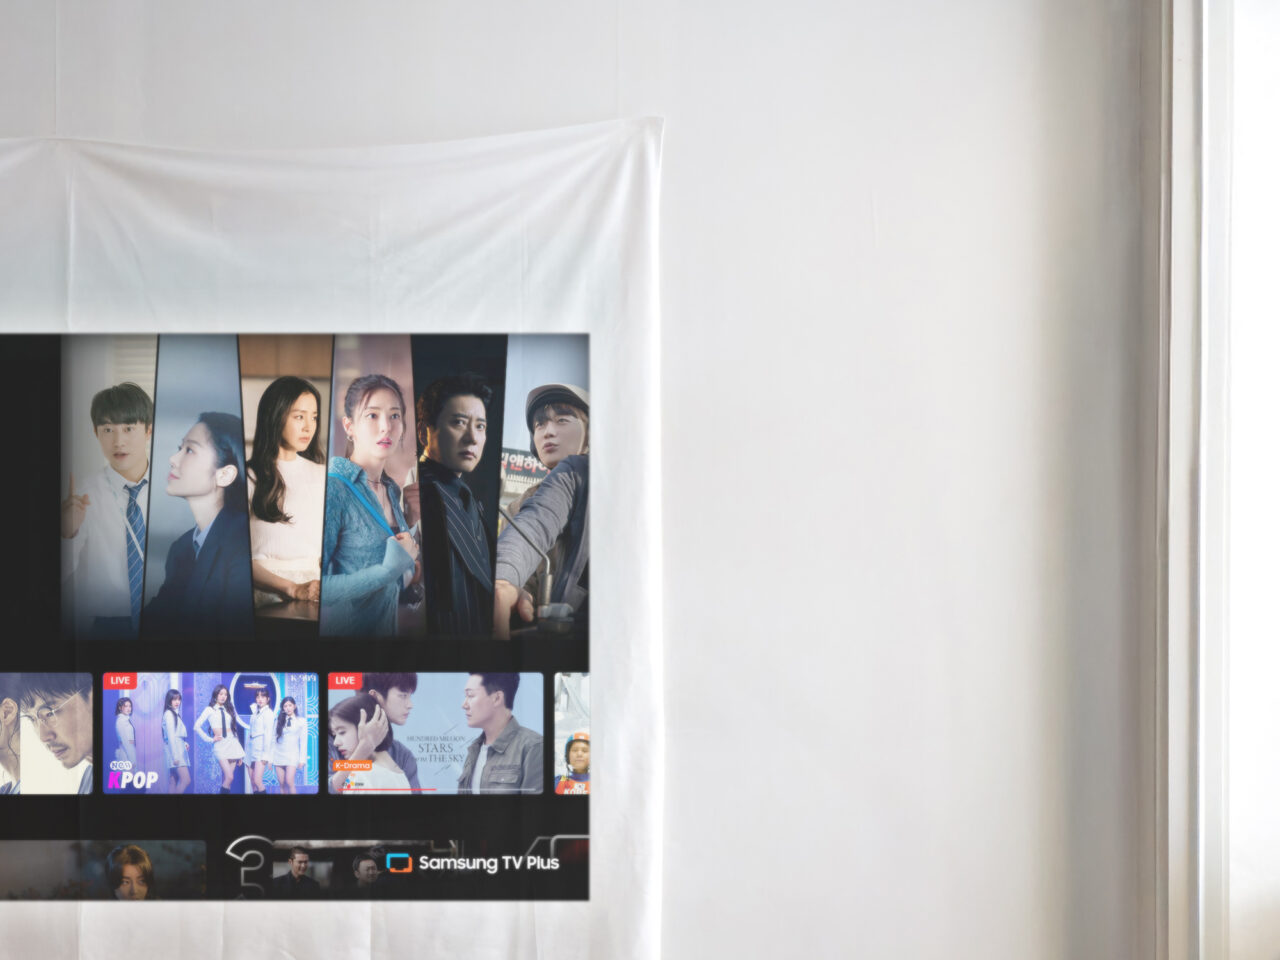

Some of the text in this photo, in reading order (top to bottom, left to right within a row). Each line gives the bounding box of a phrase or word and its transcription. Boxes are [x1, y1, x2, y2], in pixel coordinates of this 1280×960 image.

[110, 675, 131, 685] LIVE
[335, 675, 356, 685] LIVE
[418, 743, 453, 753] STARS
[335, 761, 371, 770] K-Drama
[107, 770, 159, 789] KPOP
[419, 855, 560, 875] Samsung TV Plus
